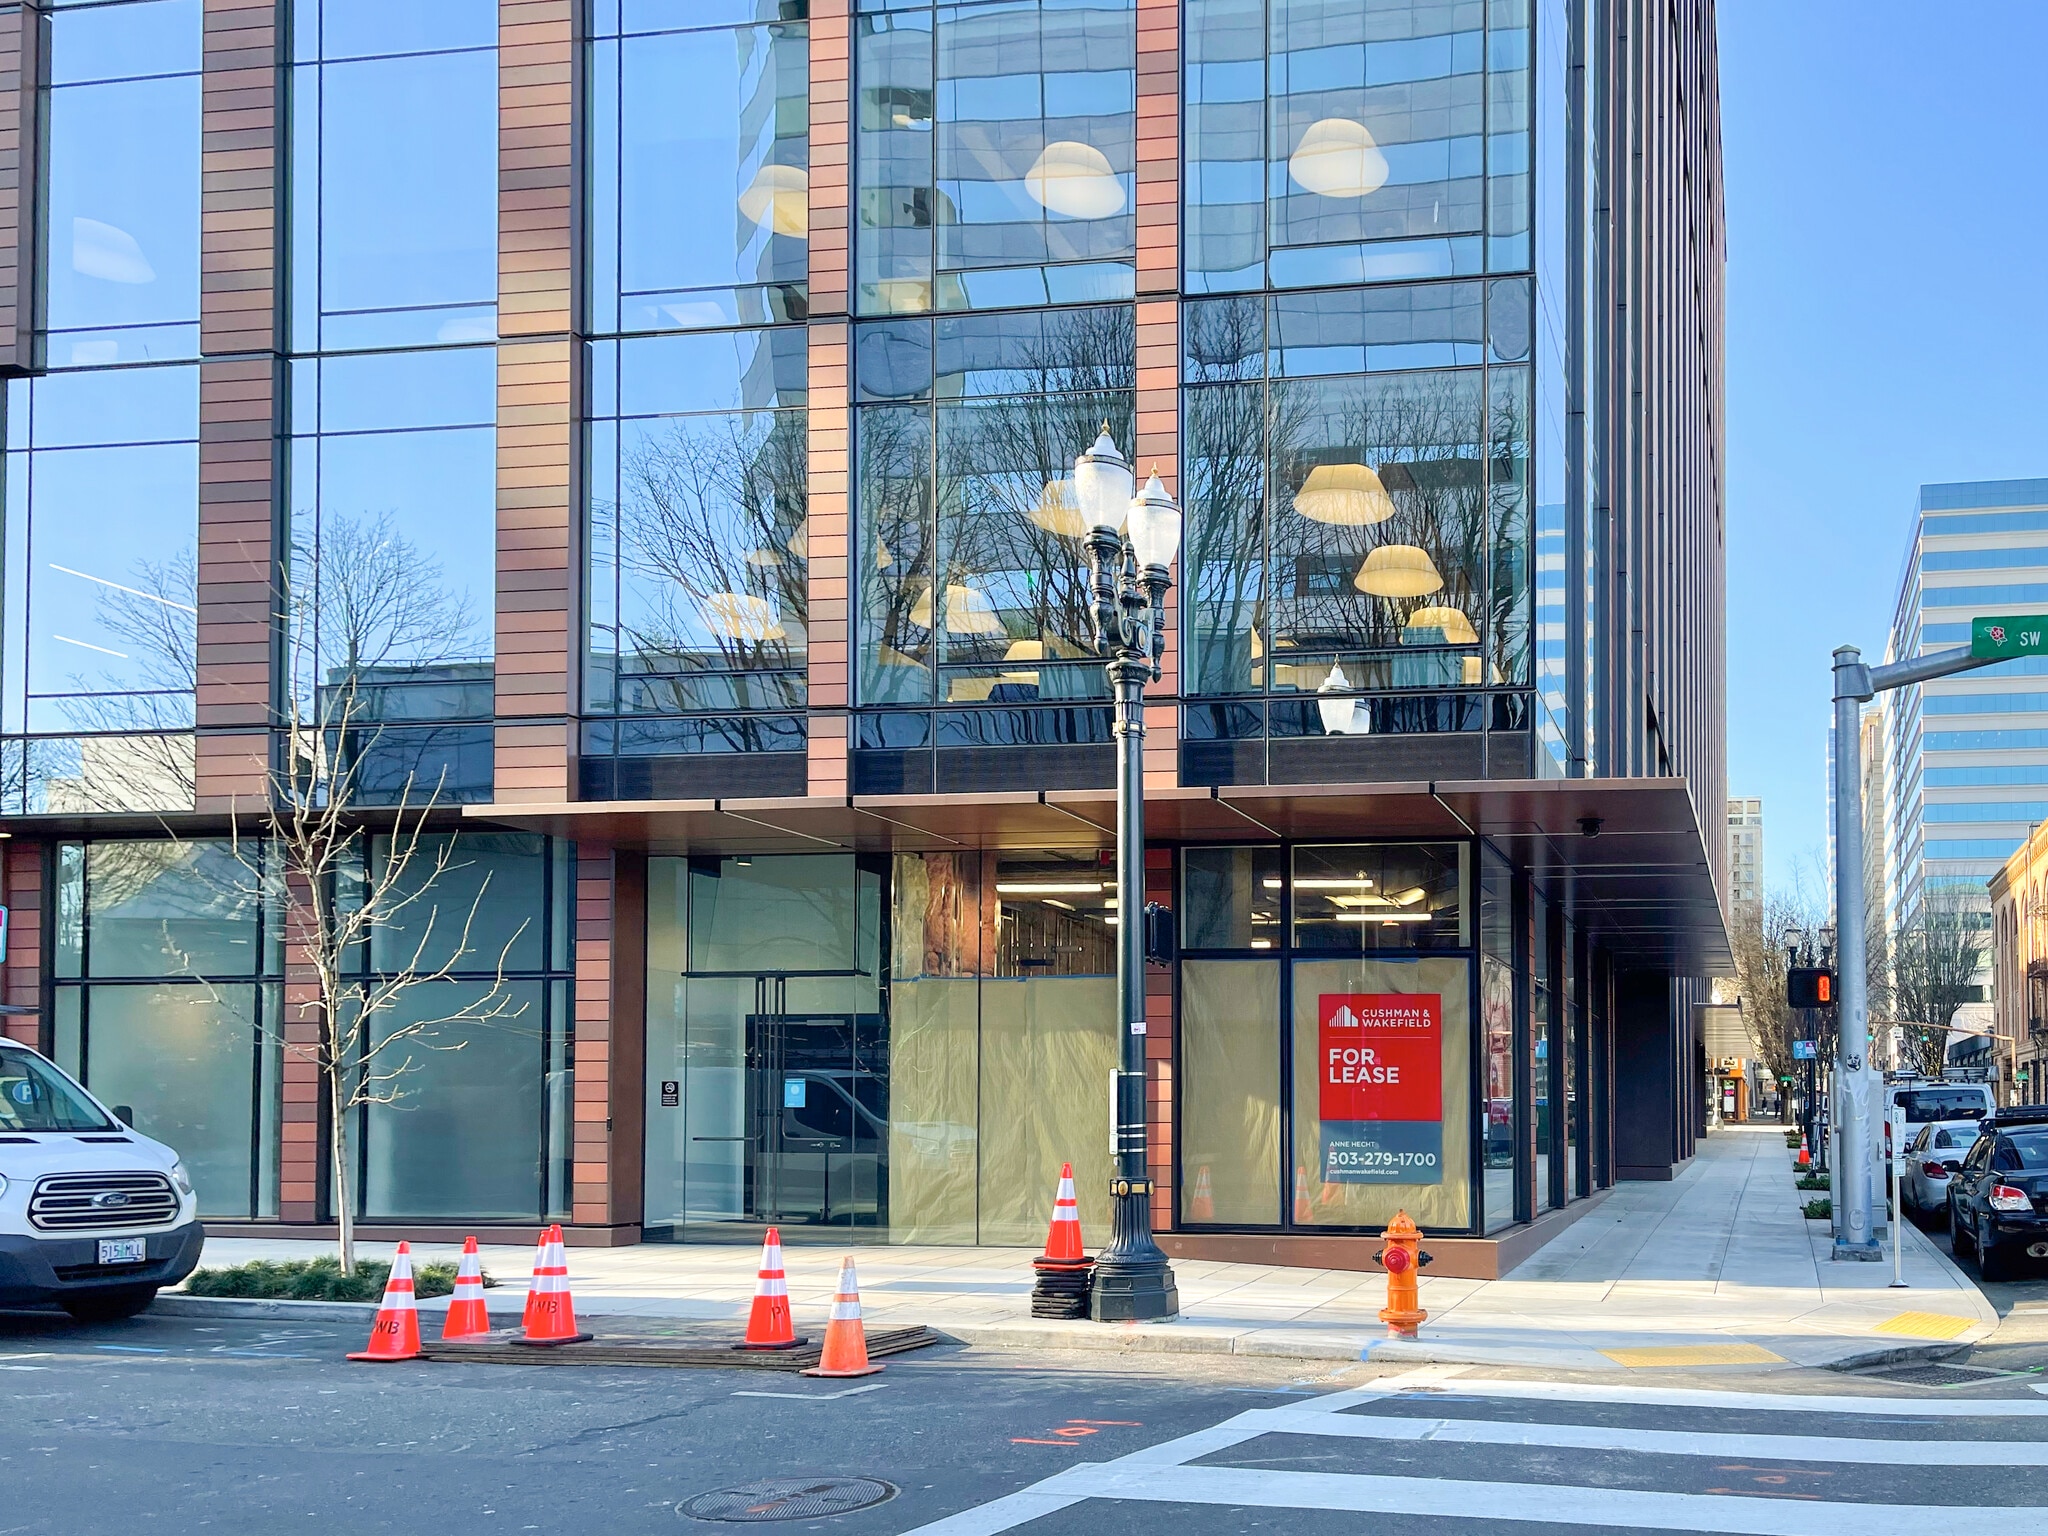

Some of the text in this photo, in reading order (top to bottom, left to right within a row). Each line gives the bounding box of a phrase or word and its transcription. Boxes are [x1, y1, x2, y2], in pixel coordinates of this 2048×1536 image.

[2020, 631, 2041, 646] SW
[1362, 1008, 1431, 1018] CUSHMAN &
[1362, 1018, 1432, 1028] WAKEFIELD
[1329, 1048, 1376, 1065] FOR
[1329, 1066, 1400, 1084] LEASE
[1329, 1151, 1437, 1167] 503-279-1700
[1329, 1168, 1400, 1176] cushmanwakefield.com
